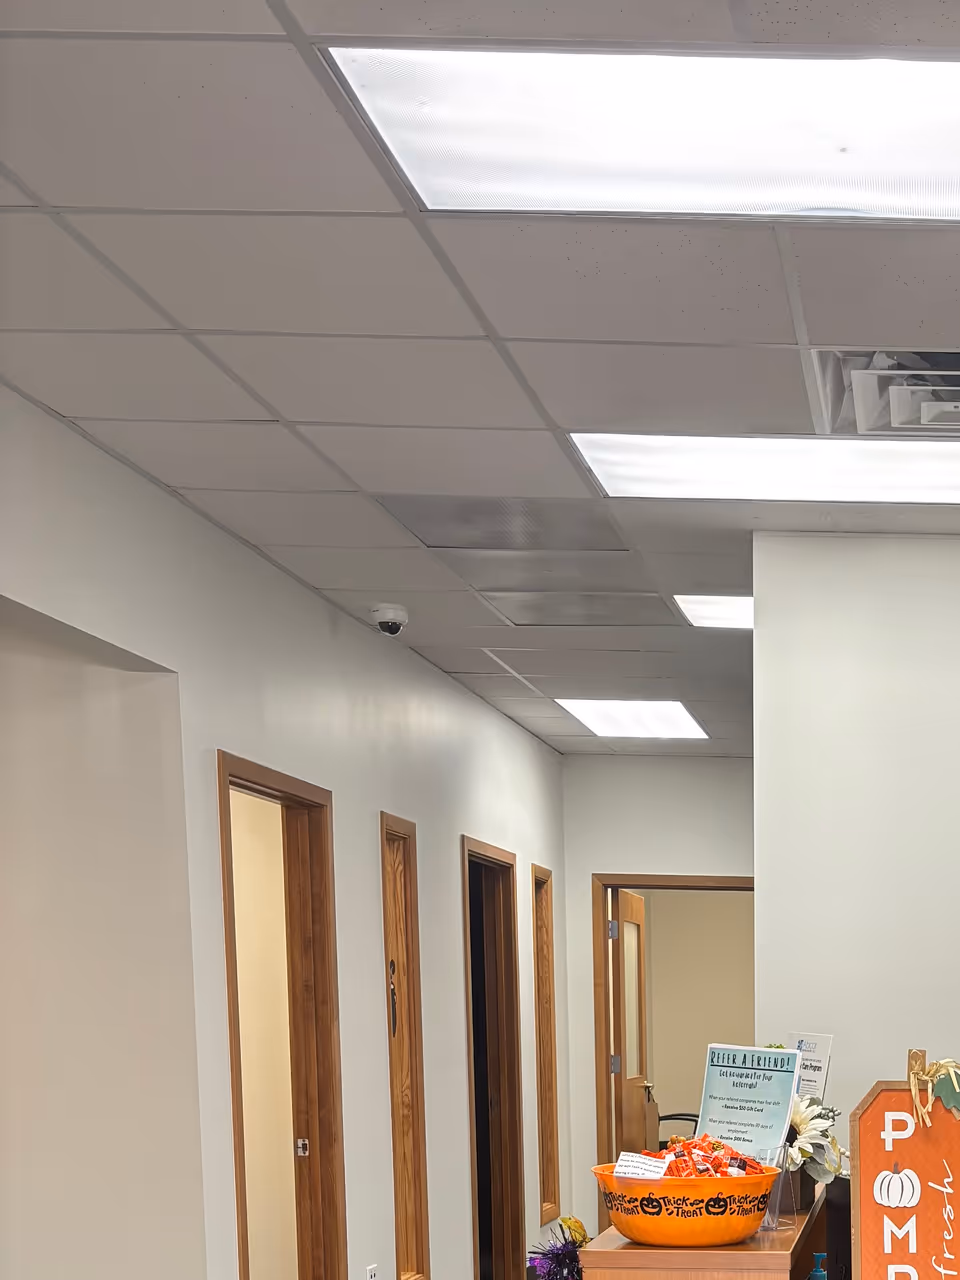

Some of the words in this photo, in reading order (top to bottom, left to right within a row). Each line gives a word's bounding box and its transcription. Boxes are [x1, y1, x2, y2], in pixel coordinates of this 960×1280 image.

[710, 1050, 737, 1065] REFER
[741, 1053, 747, 1066] A
[751, 1054, 790, 1070] FRIEND!
[927, 1159, 958, 1280] fresh
